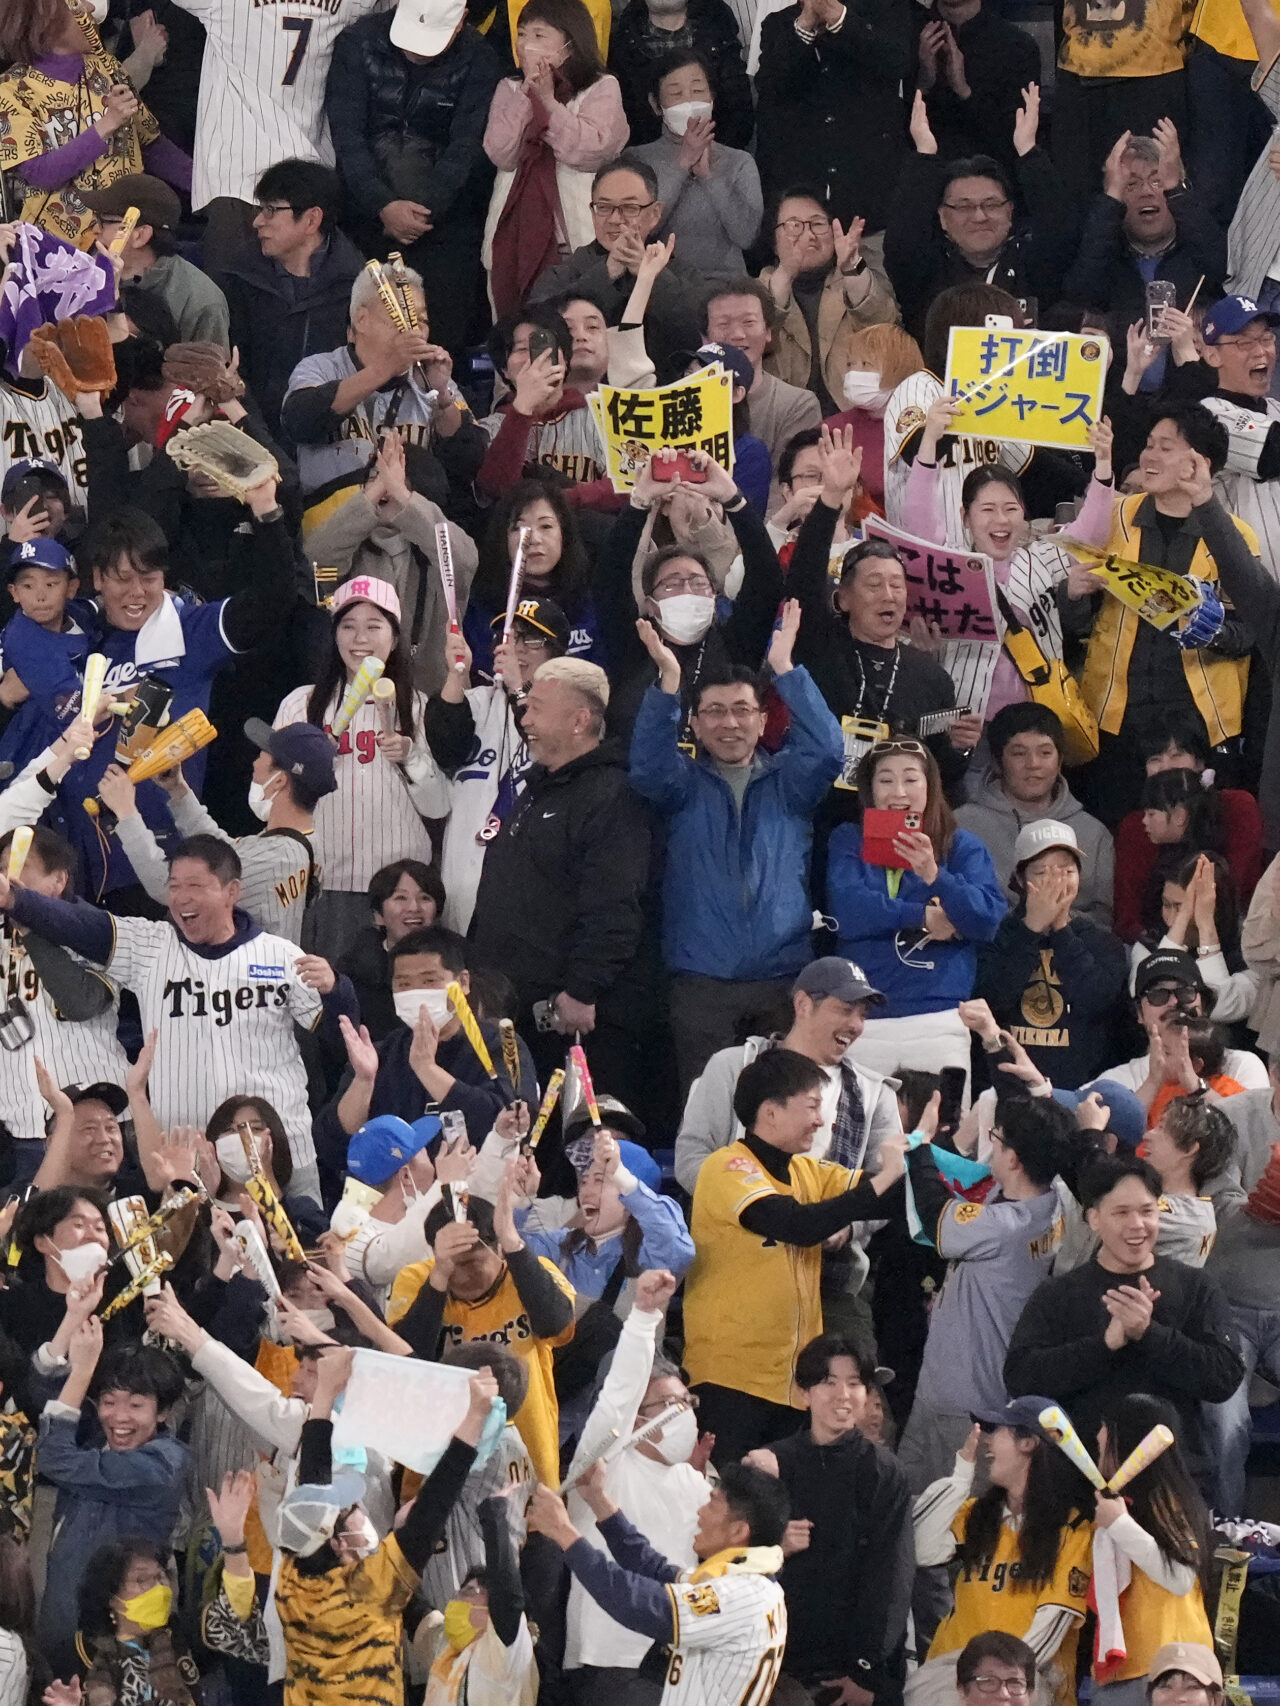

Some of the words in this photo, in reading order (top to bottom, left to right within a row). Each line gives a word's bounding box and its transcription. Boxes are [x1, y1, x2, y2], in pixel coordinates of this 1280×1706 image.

[282, 16, 313, 86] 7
[979, 333, 1067, 382] 打倒
[607, 387, 701, 441] 佐藤
[950, 378, 1094, 426] ドジャース
[4, 419, 83, 466] Tig
[20, 542, 37, 559] LA
[439, 529, 455, 588] HANSHIN
[249, 965, 285, 979] Joshin
[848, 961, 868, 982] LA
[163, 976, 291, 1027] Tigers
[1010, 1029, 1070, 1047] VIENNA
